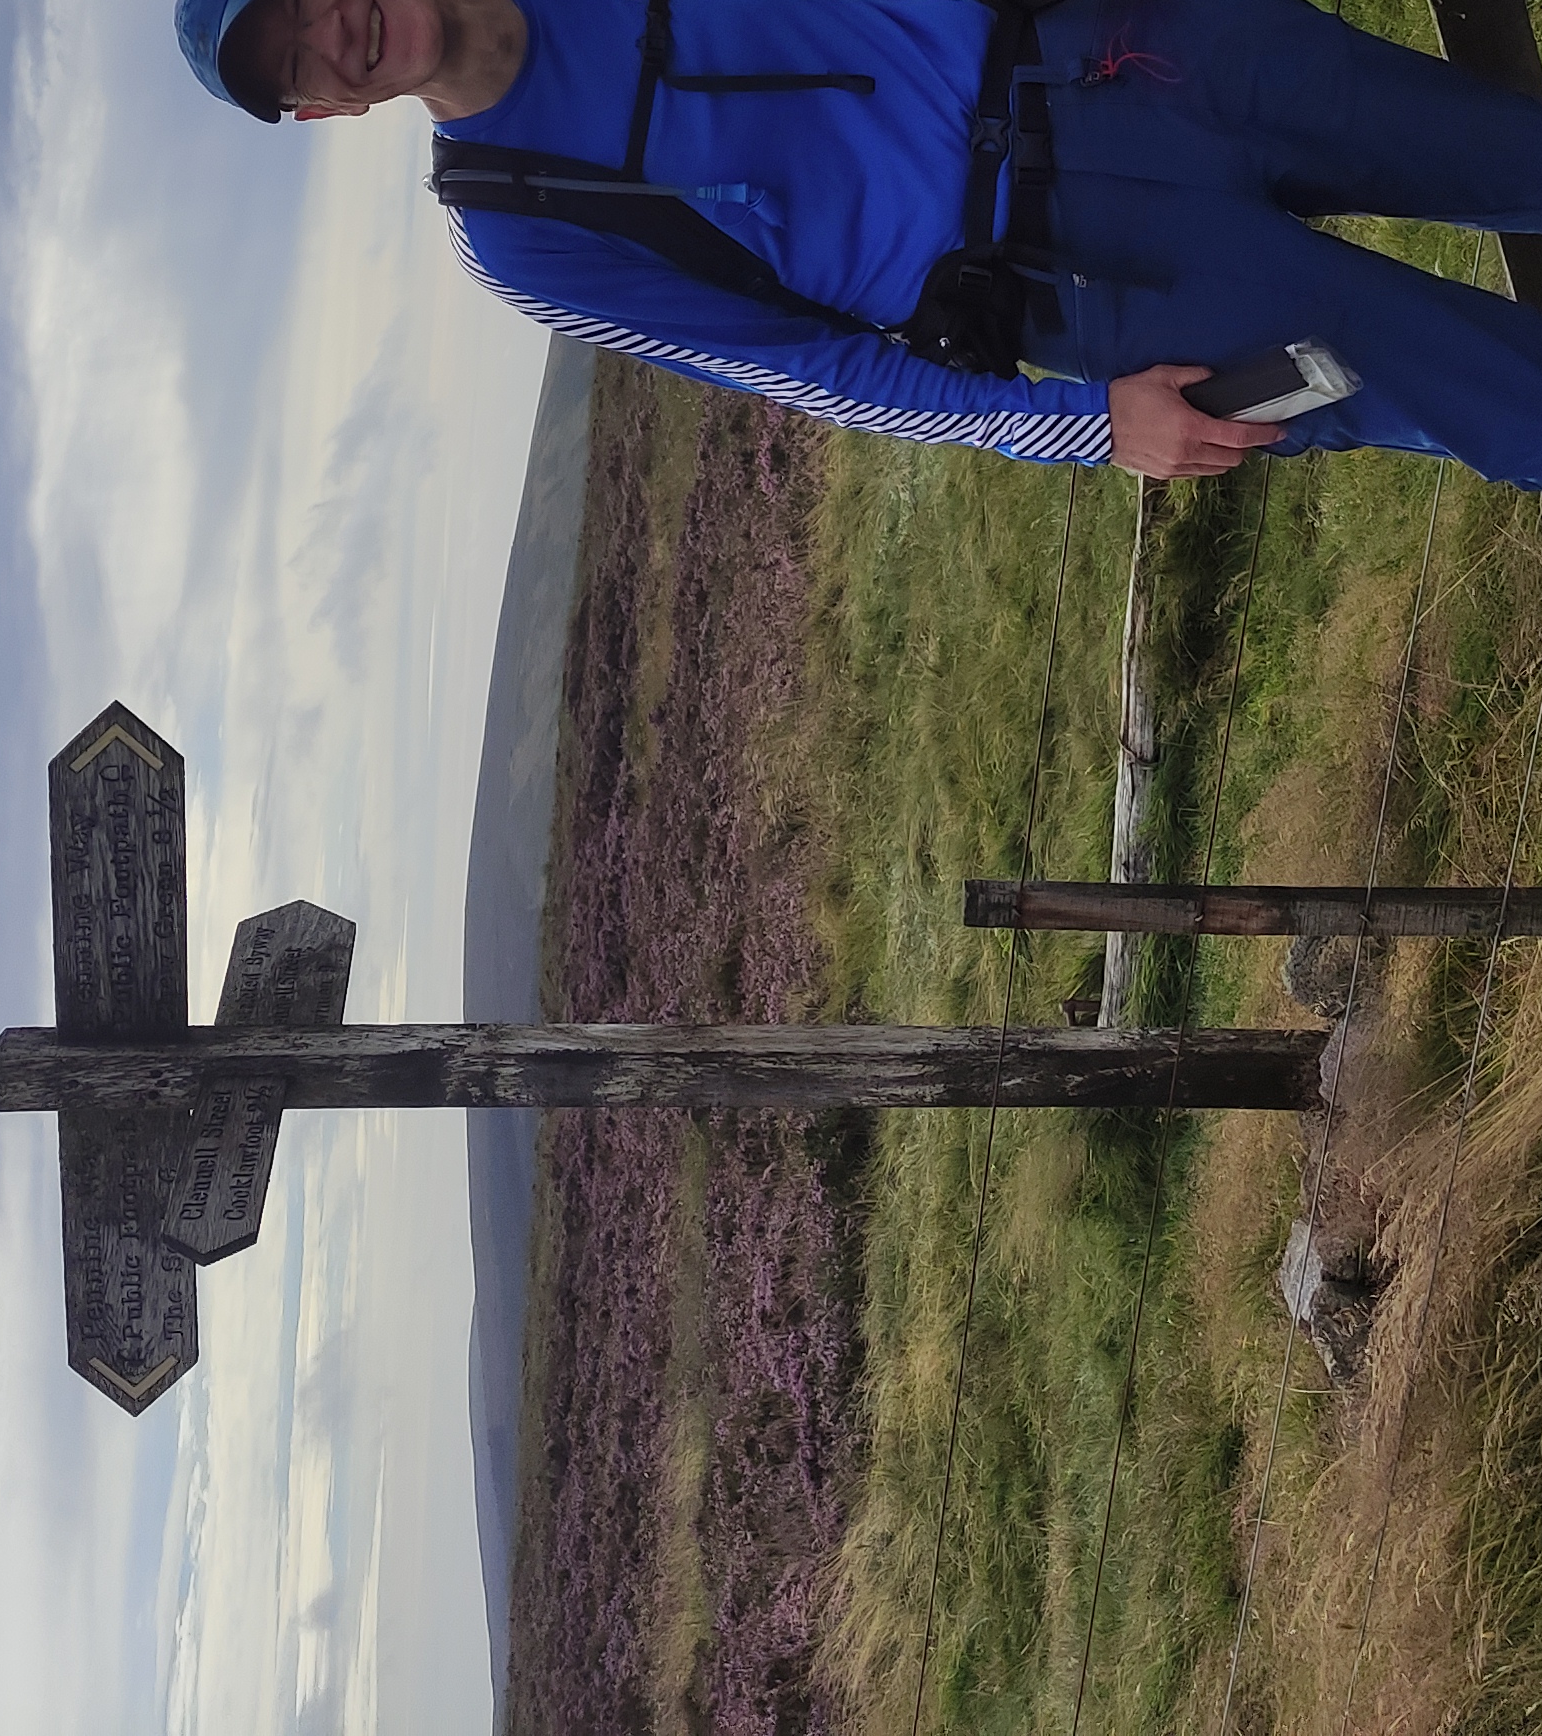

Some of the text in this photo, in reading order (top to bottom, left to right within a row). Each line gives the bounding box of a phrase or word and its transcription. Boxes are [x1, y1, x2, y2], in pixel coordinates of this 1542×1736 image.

[105, 788, 136, 921] Footpath
[152, 862, 176, 940] Green
[64, 815, 96, 1024] ennine Way
[244, 926, 276, 965] Byway
[178, 1089, 233, 1221] Clennell Street
[78, 1217, 105, 1342] Pennine
[116, 1116, 145, 1343] Public Footpath
[161, 1286, 184, 1342] The
